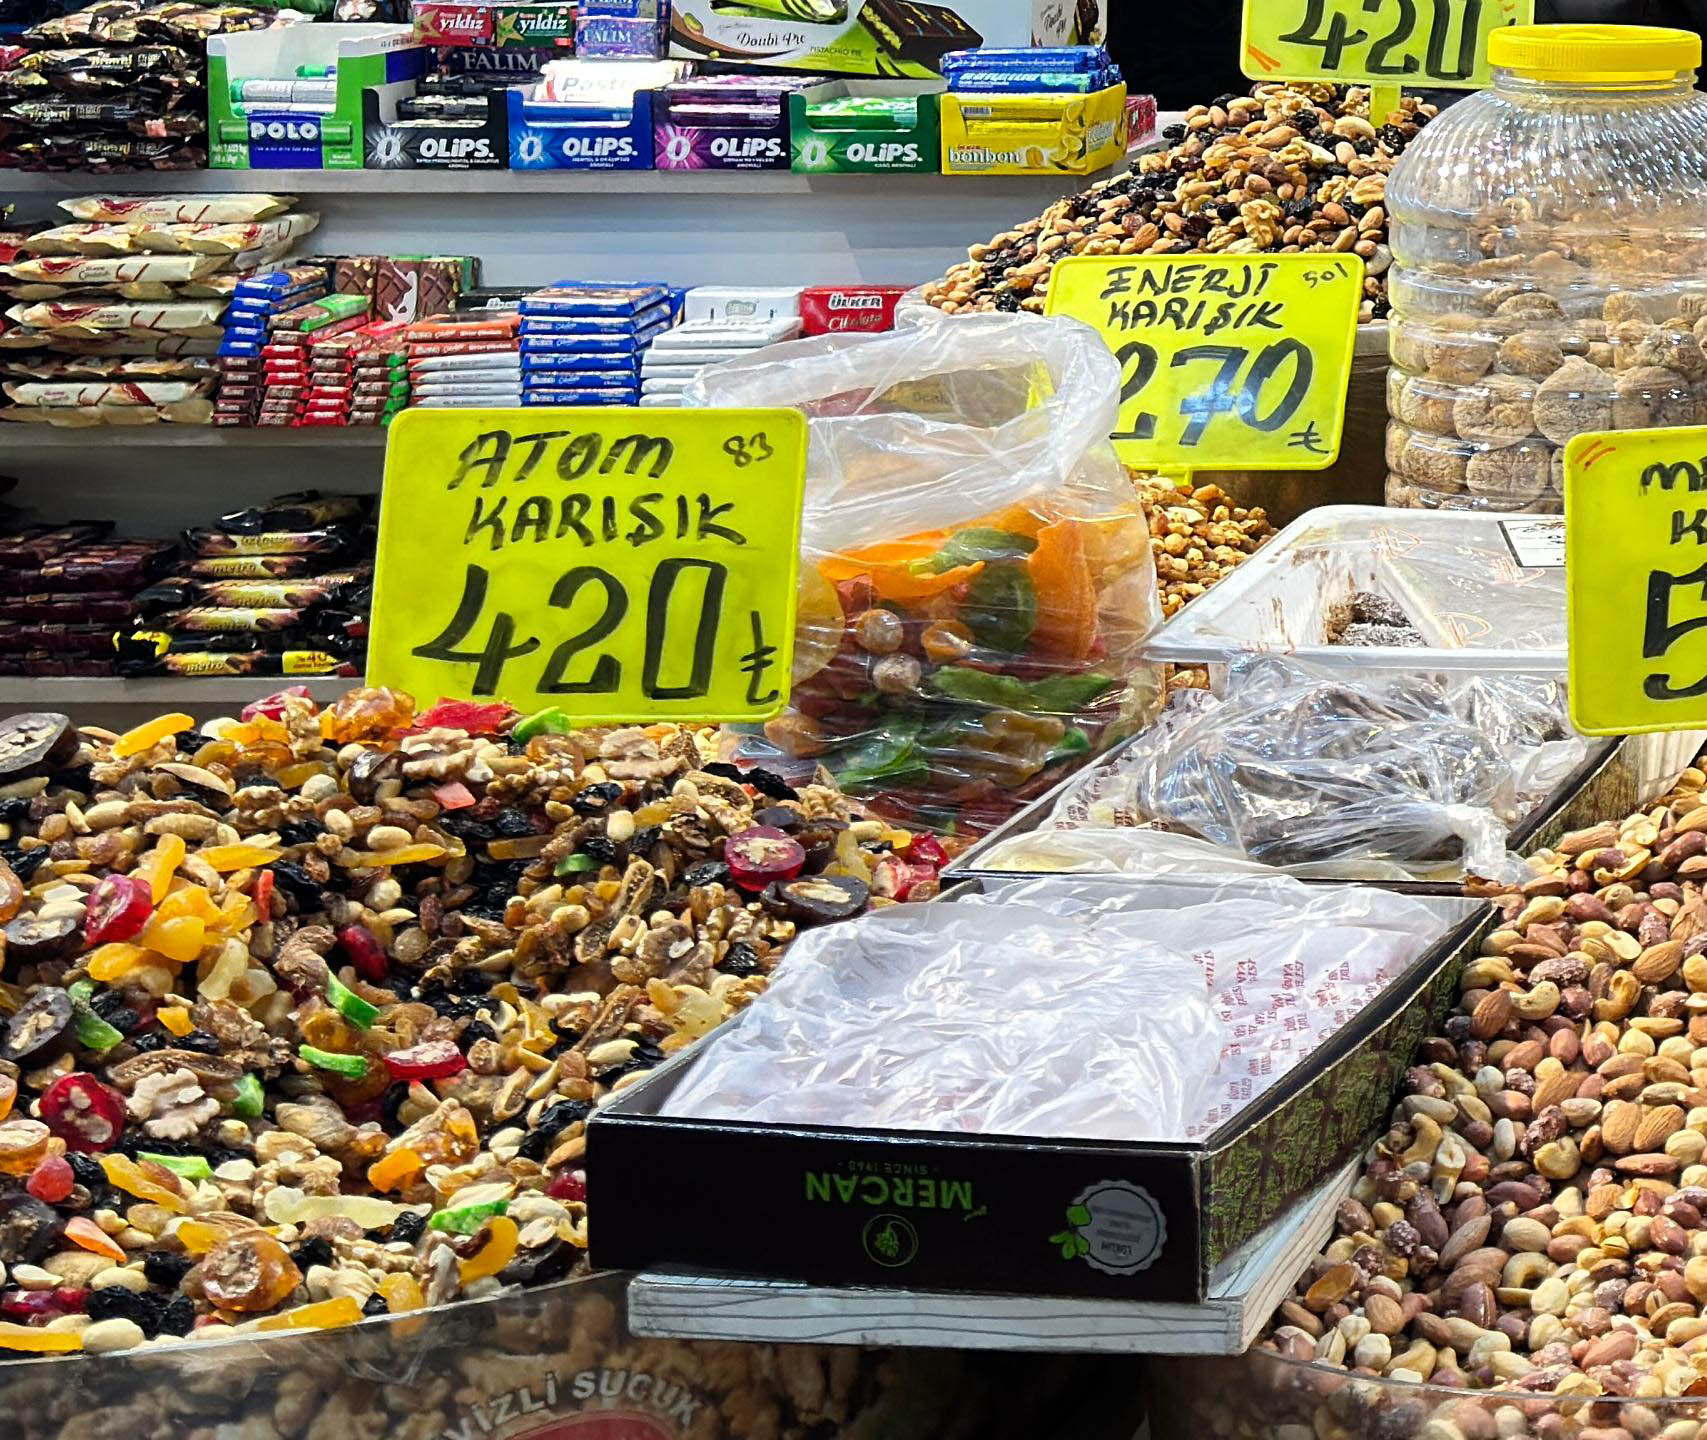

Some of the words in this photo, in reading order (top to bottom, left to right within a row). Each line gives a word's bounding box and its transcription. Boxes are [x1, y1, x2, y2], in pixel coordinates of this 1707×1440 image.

[583, 30, 632, 44] FALIM
[737, 32, 779, 49] Doubi
[810, 44, 850, 56] PISTACHIO
[849, 47, 863, 57] PIE
[464, 52, 538, 71] FALIM
[250, 122, 319, 140] POLO
[948, 147, 1021, 164] bonbon
[828, 293, 882, 310] ÜLKER
[1109, 298, 1285, 337] KARIŞIK
[447, 430, 677, 491] ATOM
[723, 432, 775, 467] 83
[465, 492, 748, 550] KARIŞIK
[804, 1170, 974, 1211] MERCAN
[571, 1370, 703, 1427] SUCUK
